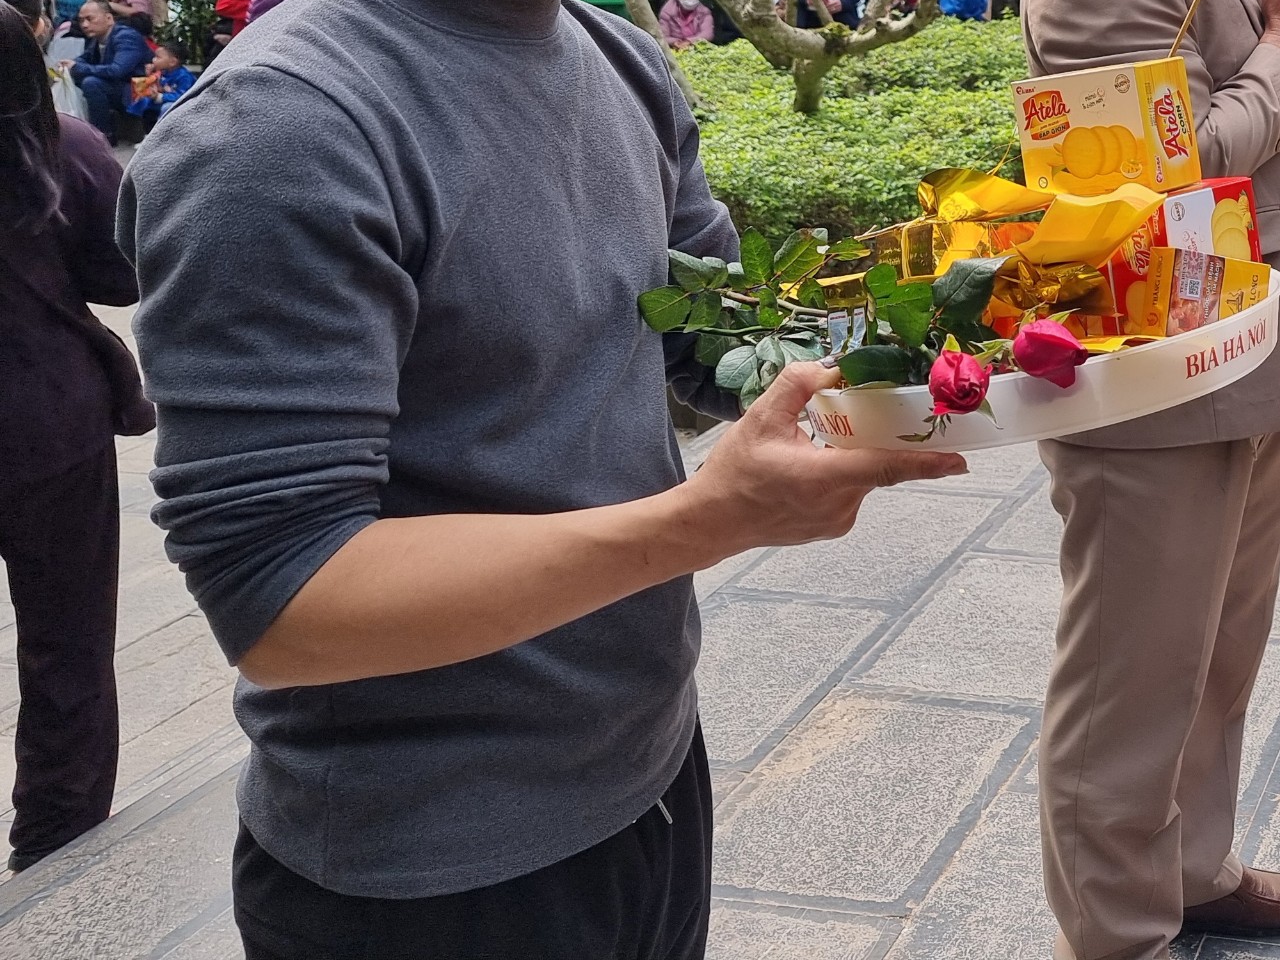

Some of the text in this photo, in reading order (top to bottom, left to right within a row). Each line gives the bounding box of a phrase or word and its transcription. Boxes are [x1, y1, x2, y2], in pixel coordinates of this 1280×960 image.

[1023, 94, 1071, 131] Atela
[1158, 87, 1189, 157] Atela
[1176, 105, 1187, 135] CORN
[1249, 274, 1258, 301] LONG
[1185, 318, 1266, 379] BIA HÀ NỘI
[810, 408, 854, 438] HÀ NỘI
